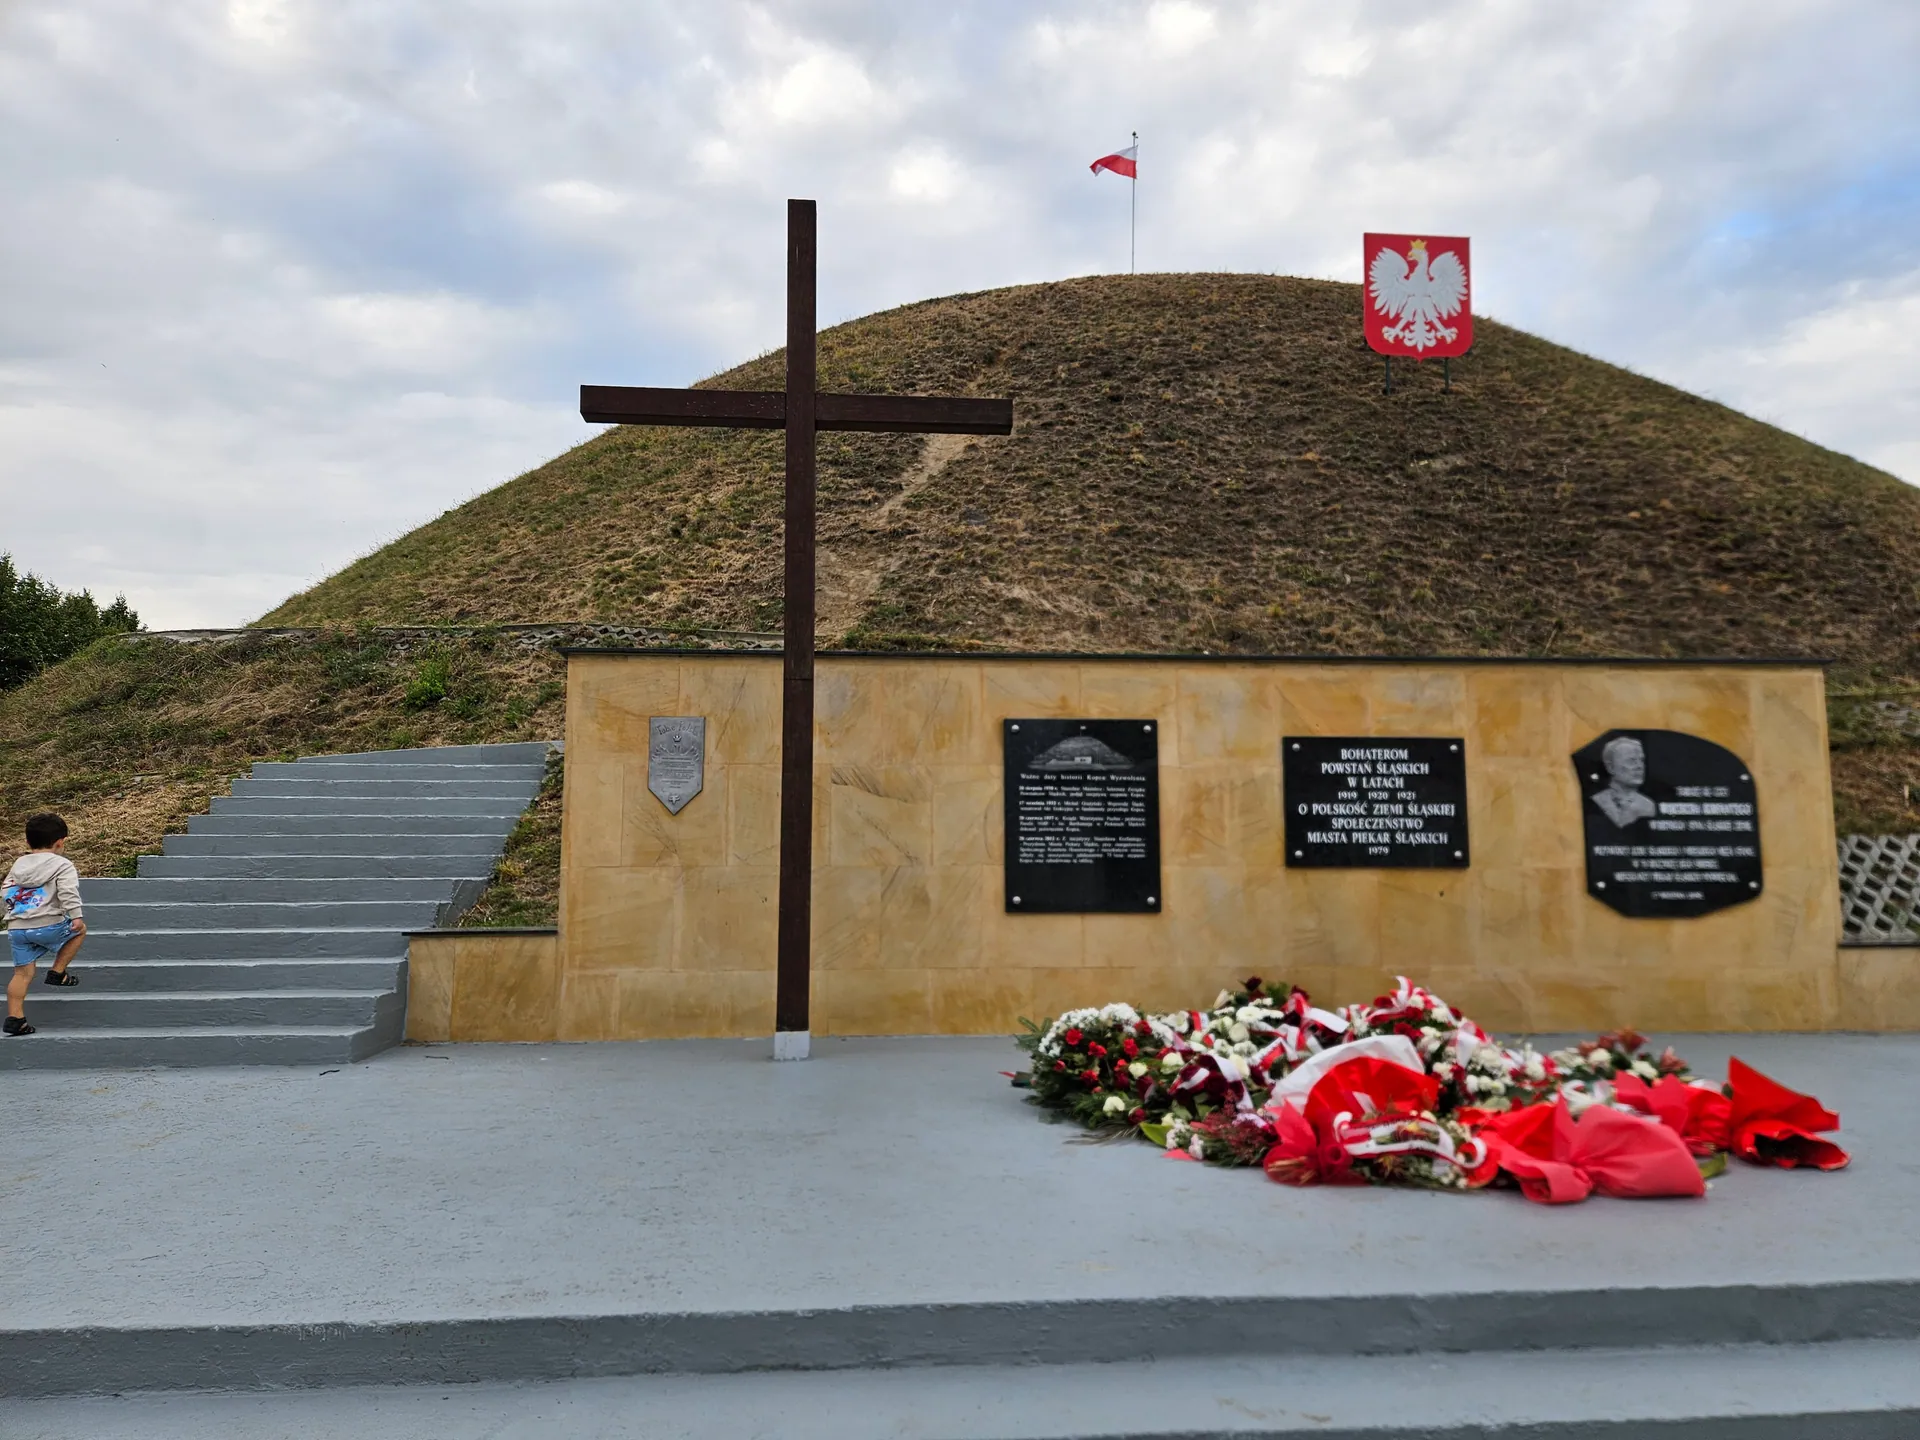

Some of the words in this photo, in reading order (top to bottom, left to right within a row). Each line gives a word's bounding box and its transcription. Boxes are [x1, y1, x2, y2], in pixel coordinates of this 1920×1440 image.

[1340, 748, 1409, 760] BOHATEROM
[1321, 760, 1373, 774] POWSTAŃ
[1376, 761, 1430, 777] ŚLĄSKICH
[1044, 773, 1057, 781] daty
[1347, 776, 1358, 788] W
[1362, 776, 1405, 789] LATACH
[1337, 790, 1359, 800] 1919
[1367, 790, 1390, 800] 1920
[1397, 791, 1417, 800] 1921
[1298, 803, 1309, 815] O
[1312, 800, 1369, 815] POLSKOŚĆ
[1372, 803, 1404, 816] ZIEMI
[1407, 802, 1456, 819] ŚLĄSKIEJ
[1331, 816, 1425, 830] SPOŁECZEŃSTWO
[1307, 832, 1348, 845] MIASTA
[1352, 832, 1391, 845] PIEKAR
[1395, 830, 1449, 847] ŚLĄSKICH
[1368, 846, 1390, 856] 1979
